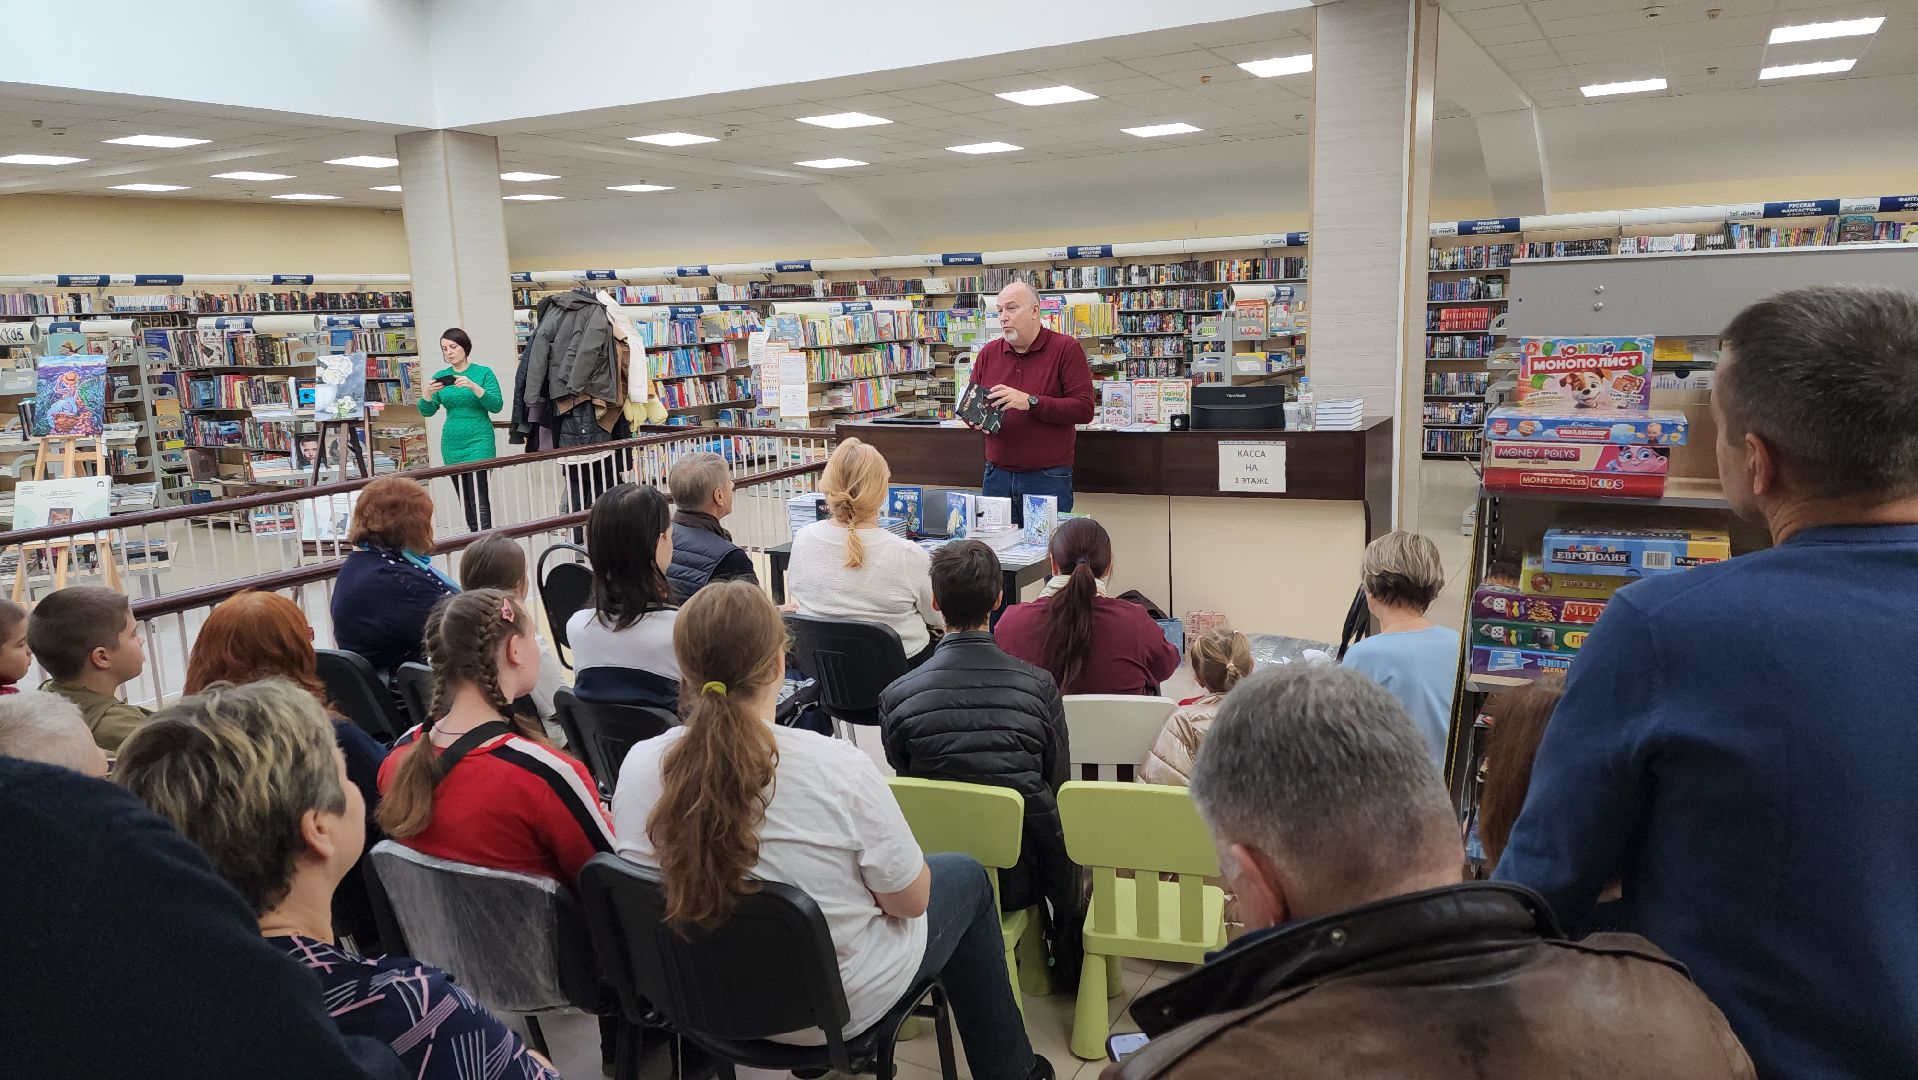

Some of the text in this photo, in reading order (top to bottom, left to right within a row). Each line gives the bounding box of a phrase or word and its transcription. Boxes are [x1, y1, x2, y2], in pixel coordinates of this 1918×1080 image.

[1561, 341, 1615, 357] ЮНЫЙ
[1533, 356, 1639, 371] МОНОПОЛИСТ
[1237, 449, 1266, 458] КАССА
[1498, 447, 1576, 459] MONEY POLYS
[1245, 464, 1258, 472] НА
[1241, 477, 1269, 485] ЭТАЖЕ
[1522, 475, 1553, 485] MONEY
[1590, 478, 1624, 490] KIDS
[1556, 551, 1627, 563] ЕВРОПОЛИЯ
